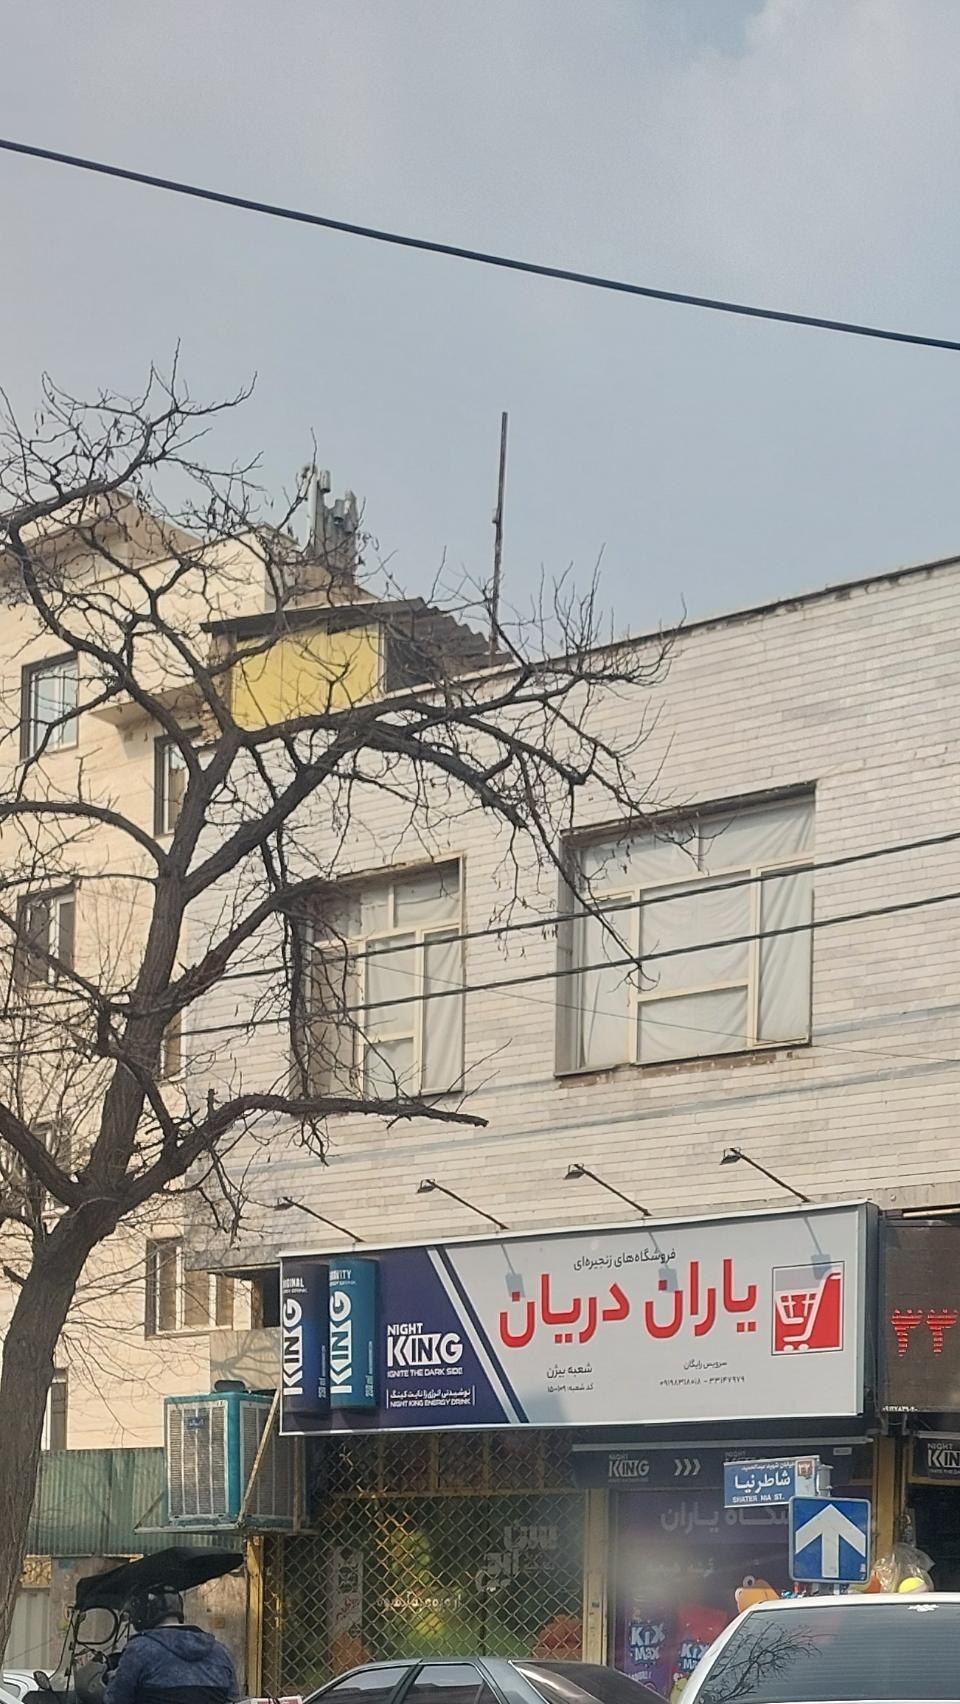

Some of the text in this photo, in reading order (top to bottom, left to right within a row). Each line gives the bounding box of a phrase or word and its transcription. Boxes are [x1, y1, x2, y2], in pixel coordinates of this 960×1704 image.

[499, 1258, 757, 1348] یاران دریان
[387, 1323, 423, 1336] NIGHT
[282, 1298, 303, 1396] KING
[329, 1291, 353, 1394] KING
[387, 1333, 463, 1367] KING
[410, 1369, 423, 1377] THE
[424, 1368, 445, 1376] DARK
[446, 1367, 463, 1375] SIDE
[568, 1362, 592, 1377] شعبه
[608, 1460, 650, 1478] KING
[735, 1470, 791, 1493] شاطرنیا
